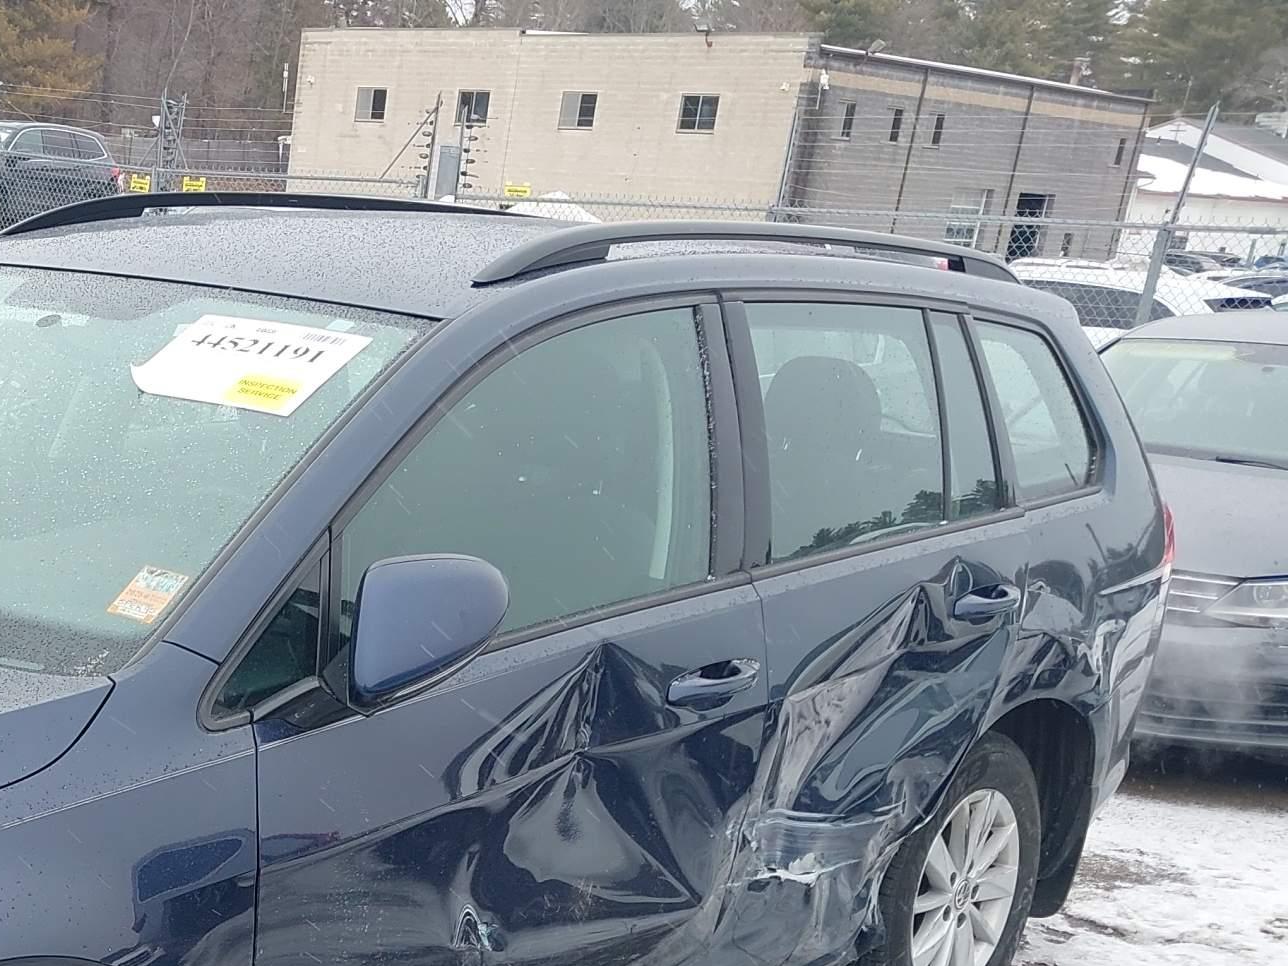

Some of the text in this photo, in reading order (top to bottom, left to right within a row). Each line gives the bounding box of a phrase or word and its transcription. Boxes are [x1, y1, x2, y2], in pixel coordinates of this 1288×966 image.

[192, 333, 326, 363] 44521191
[237, 387, 281, 401] SERVICE
[238, 379, 297, 395] INSPECTION
